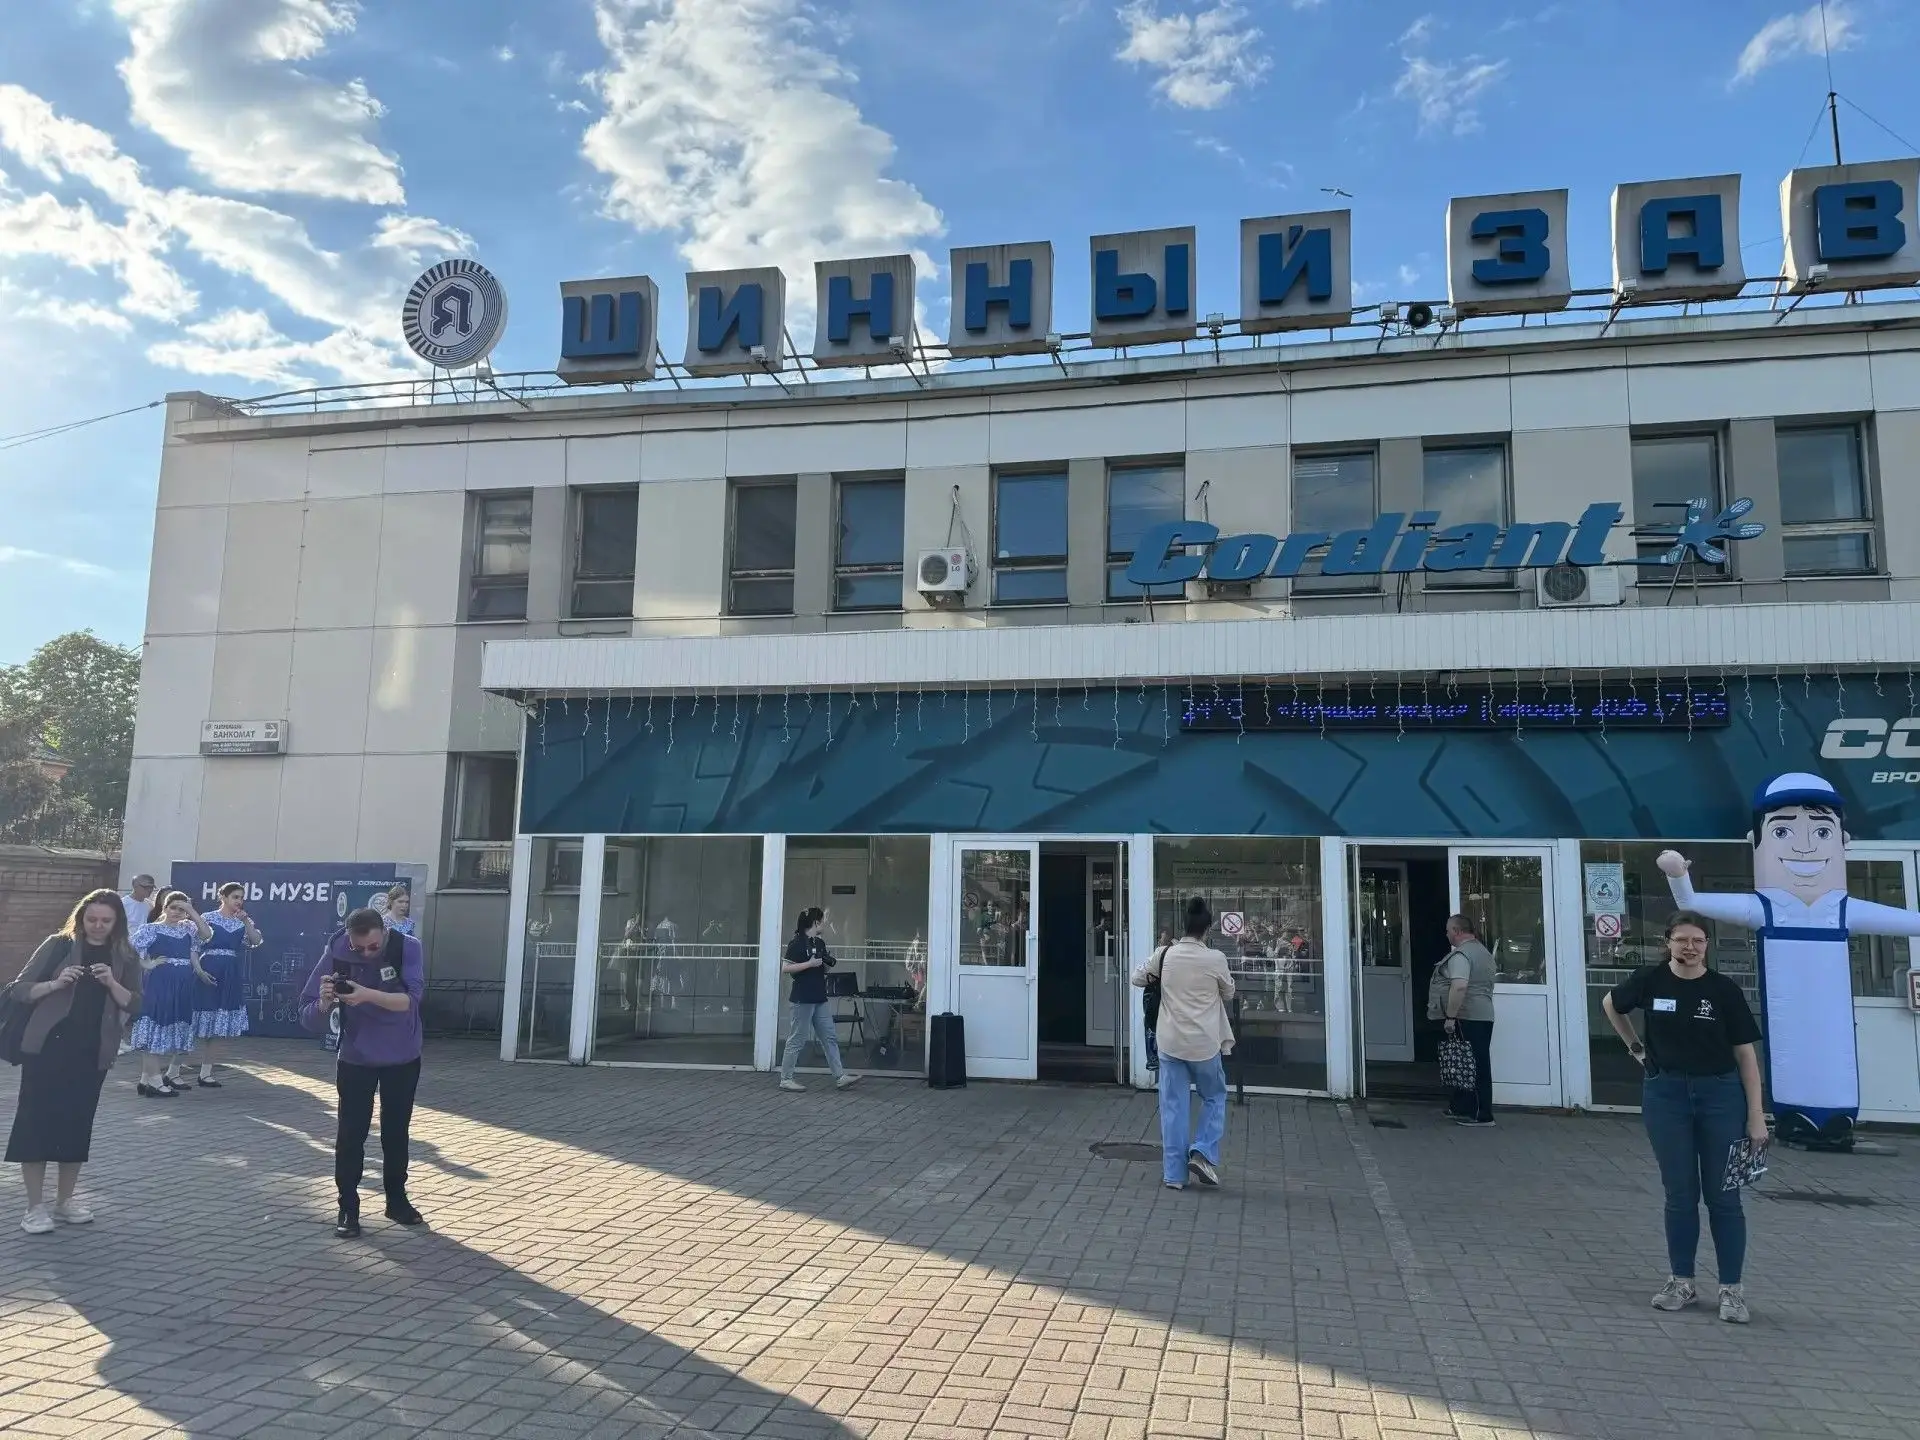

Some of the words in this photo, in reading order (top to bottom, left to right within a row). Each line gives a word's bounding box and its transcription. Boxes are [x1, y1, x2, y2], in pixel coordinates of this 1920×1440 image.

[561, 224, 1332, 359] ШИННЫЙ
[1471, 180, 1906, 284] ЗАВ
[1125, 502, 1625, 585] Cordiant
[213, 730, 256, 739] БАНКОМАТ
[269, 882, 333, 902] МУЗЕ
